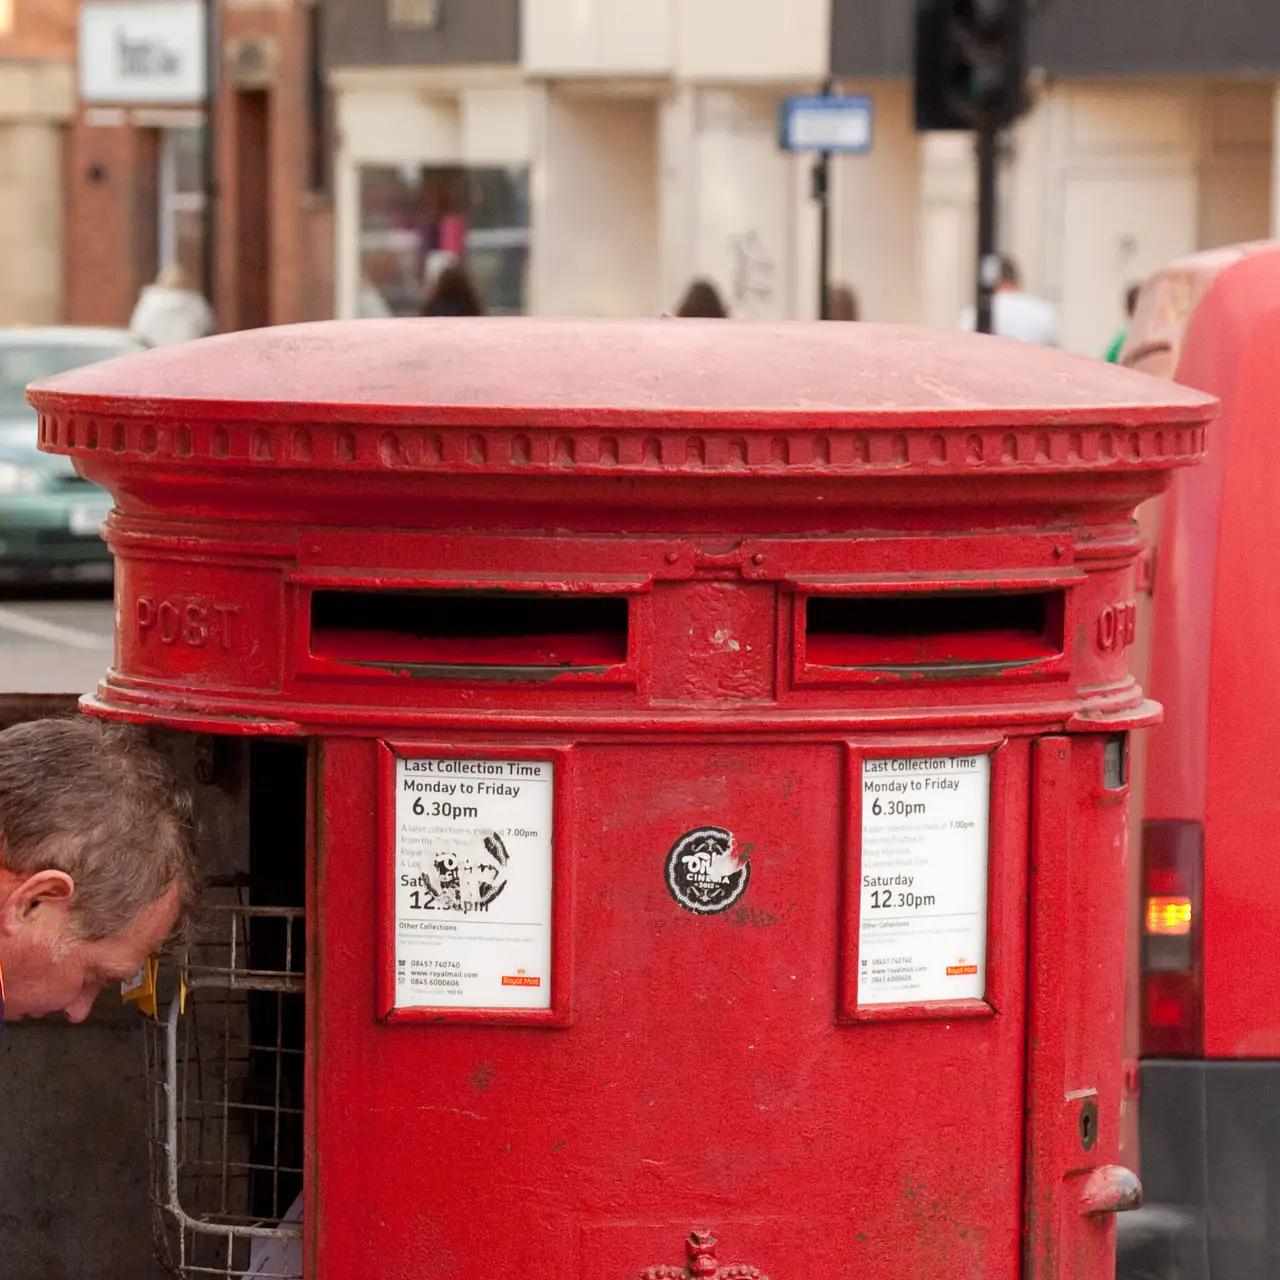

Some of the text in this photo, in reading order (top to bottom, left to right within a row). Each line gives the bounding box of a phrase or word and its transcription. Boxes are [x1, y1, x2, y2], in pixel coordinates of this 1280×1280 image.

[136, 597, 241, 655] POST
[404, 759, 541, 776] Last Collection Time
[864, 756, 977, 772] Last Collection Time
[404, 779, 520, 798] Monday to Friday
[864, 777, 960, 794] Monday to Friday
[412, 796, 478, 820] 6.30pm
[871, 796, 926, 817] 6.30pm
[949, 820, 975, 829] 7.00pm
[507, 828, 538, 838] 7.00pm
[863, 873, 914, 888] Saturday
[870, 889, 935, 910] 12.30pm
[399, 922, 457, 932] Other Collections
[411, 960, 461, 969] 08457 740740
[410, 969, 479, 979] www.royalmail.com
[503, 977, 539, 986] Royal Mail
